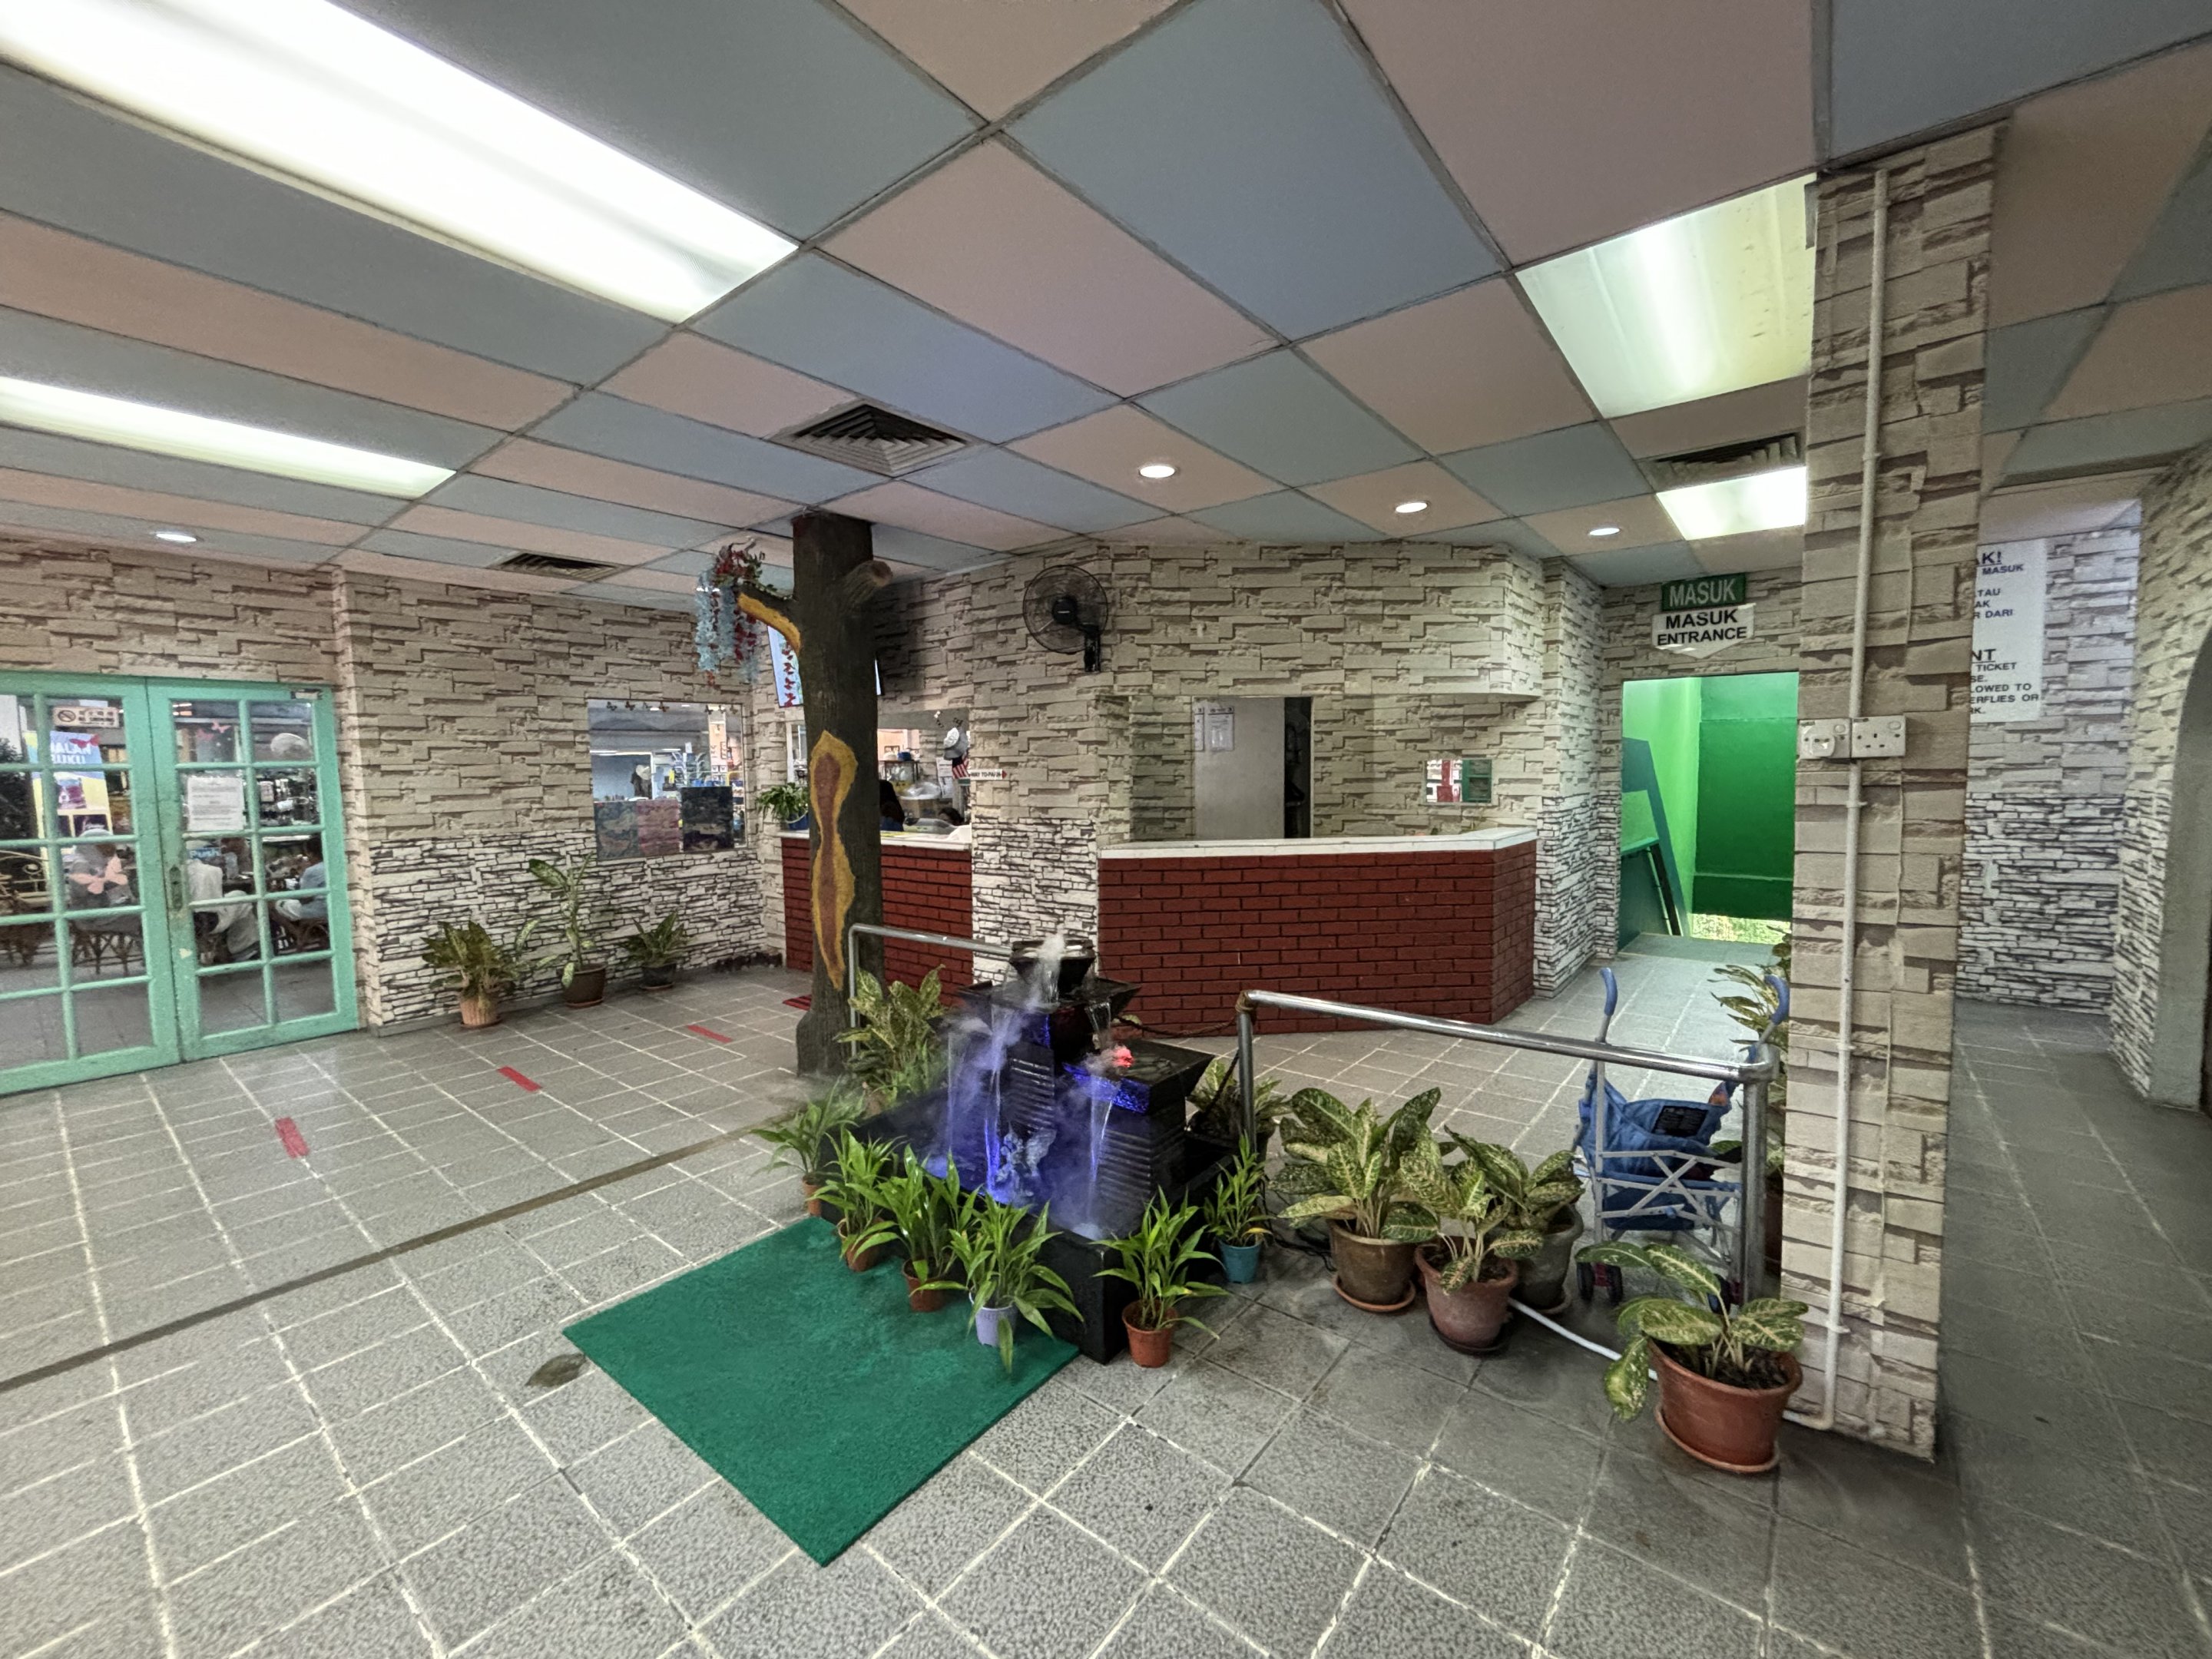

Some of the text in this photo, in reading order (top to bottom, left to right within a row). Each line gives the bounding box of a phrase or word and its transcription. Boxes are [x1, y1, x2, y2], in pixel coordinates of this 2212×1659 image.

[1976, 551, 2002, 565] K!
[1982, 564, 2024, 575] MASUK
[1669, 578, 1737, 607] MASUK
[1975, 588, 2002, 597] TAU
[1985, 608, 2013, 618] DARI
[1665, 608, 1738, 630] MASUK
[1657, 626, 1747, 646] ENTRANCE
[1976, 662, 2017, 672] TICKET
[2022, 694, 2039, 702] OR
